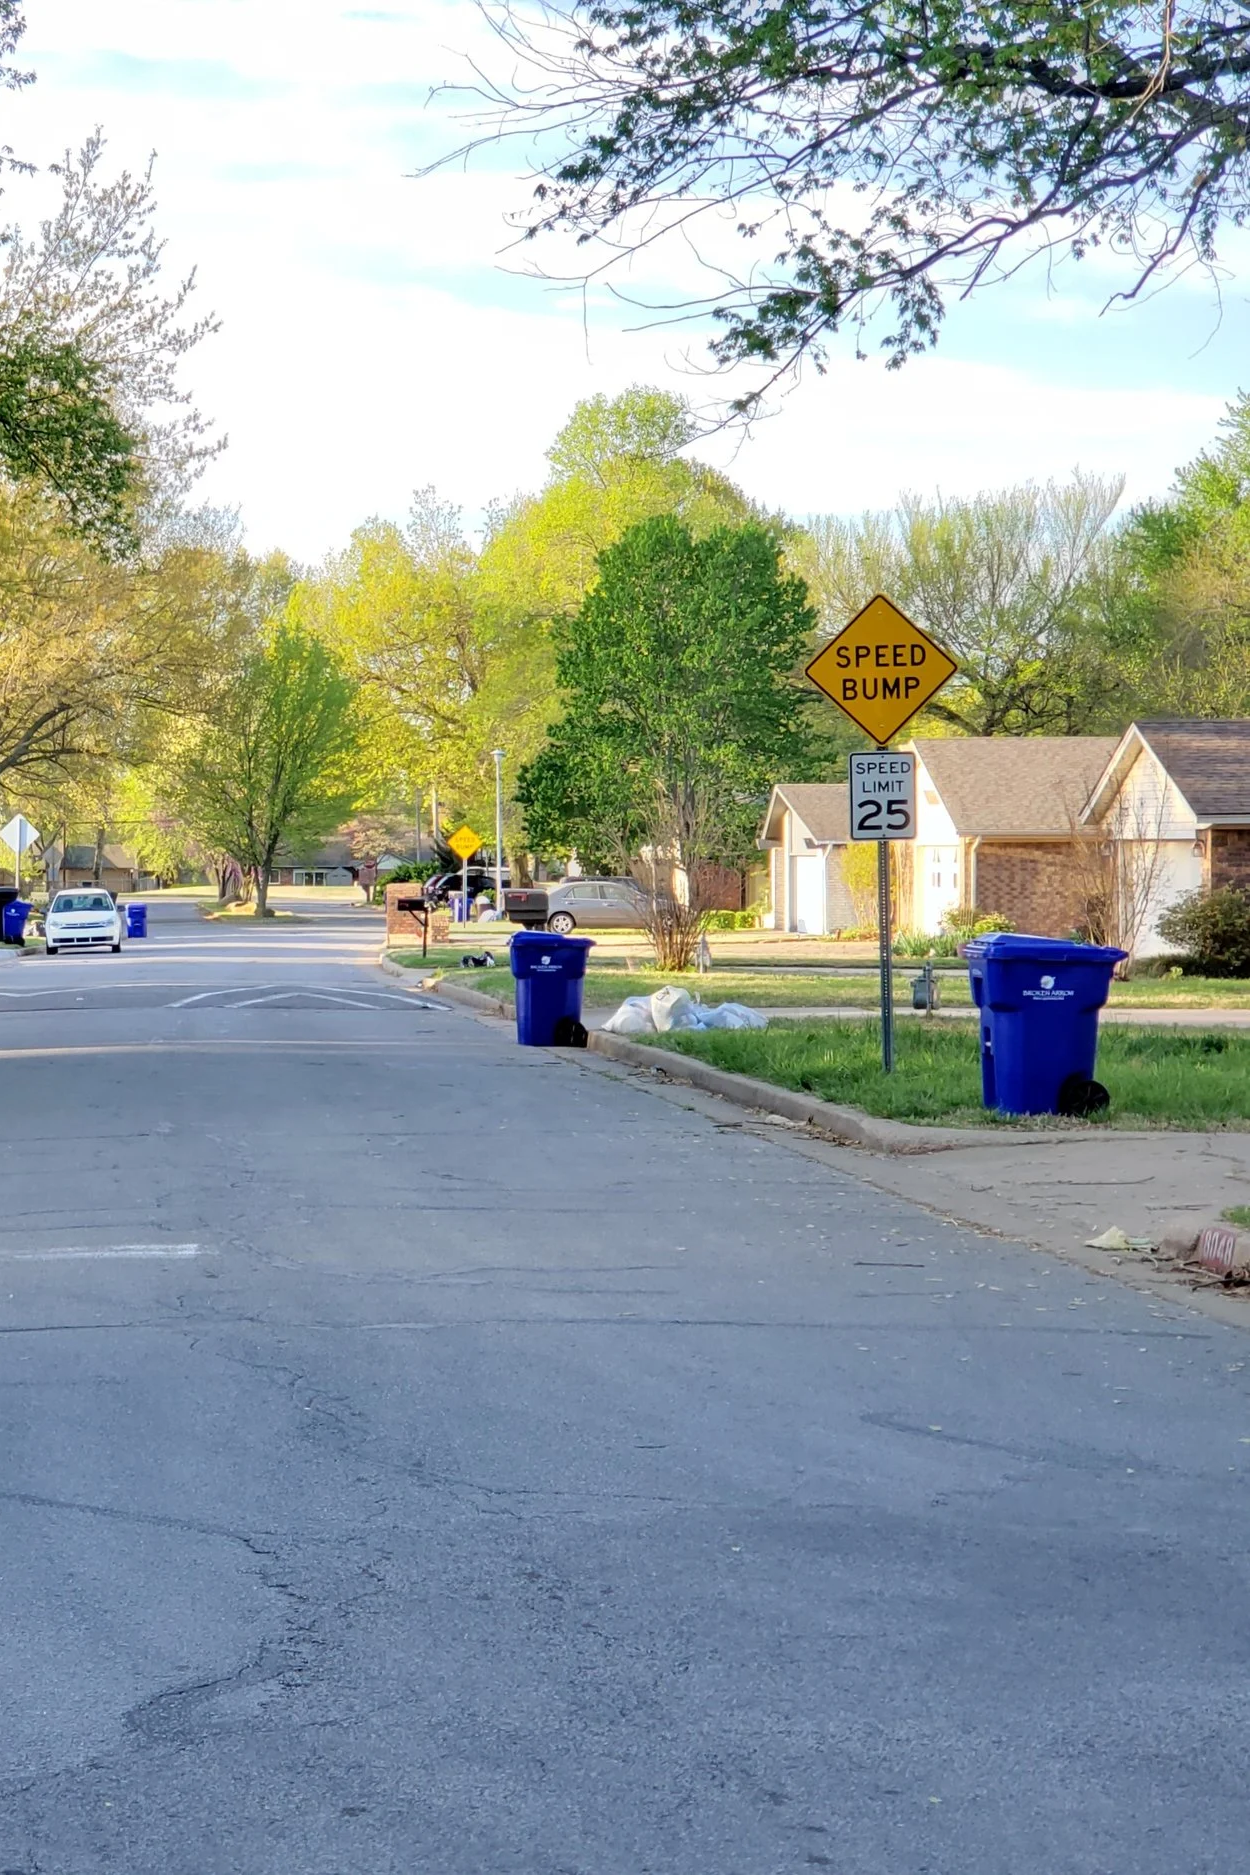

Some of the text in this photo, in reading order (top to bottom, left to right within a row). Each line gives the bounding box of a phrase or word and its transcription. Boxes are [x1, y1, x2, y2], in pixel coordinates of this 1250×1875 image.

[836, 644, 926, 668] SPEED
[842, 677, 920, 700] BUMP
[855, 761, 911, 775] SPEED
[862, 780, 905, 793] LIMIT
[857, 799, 911, 830] 25
